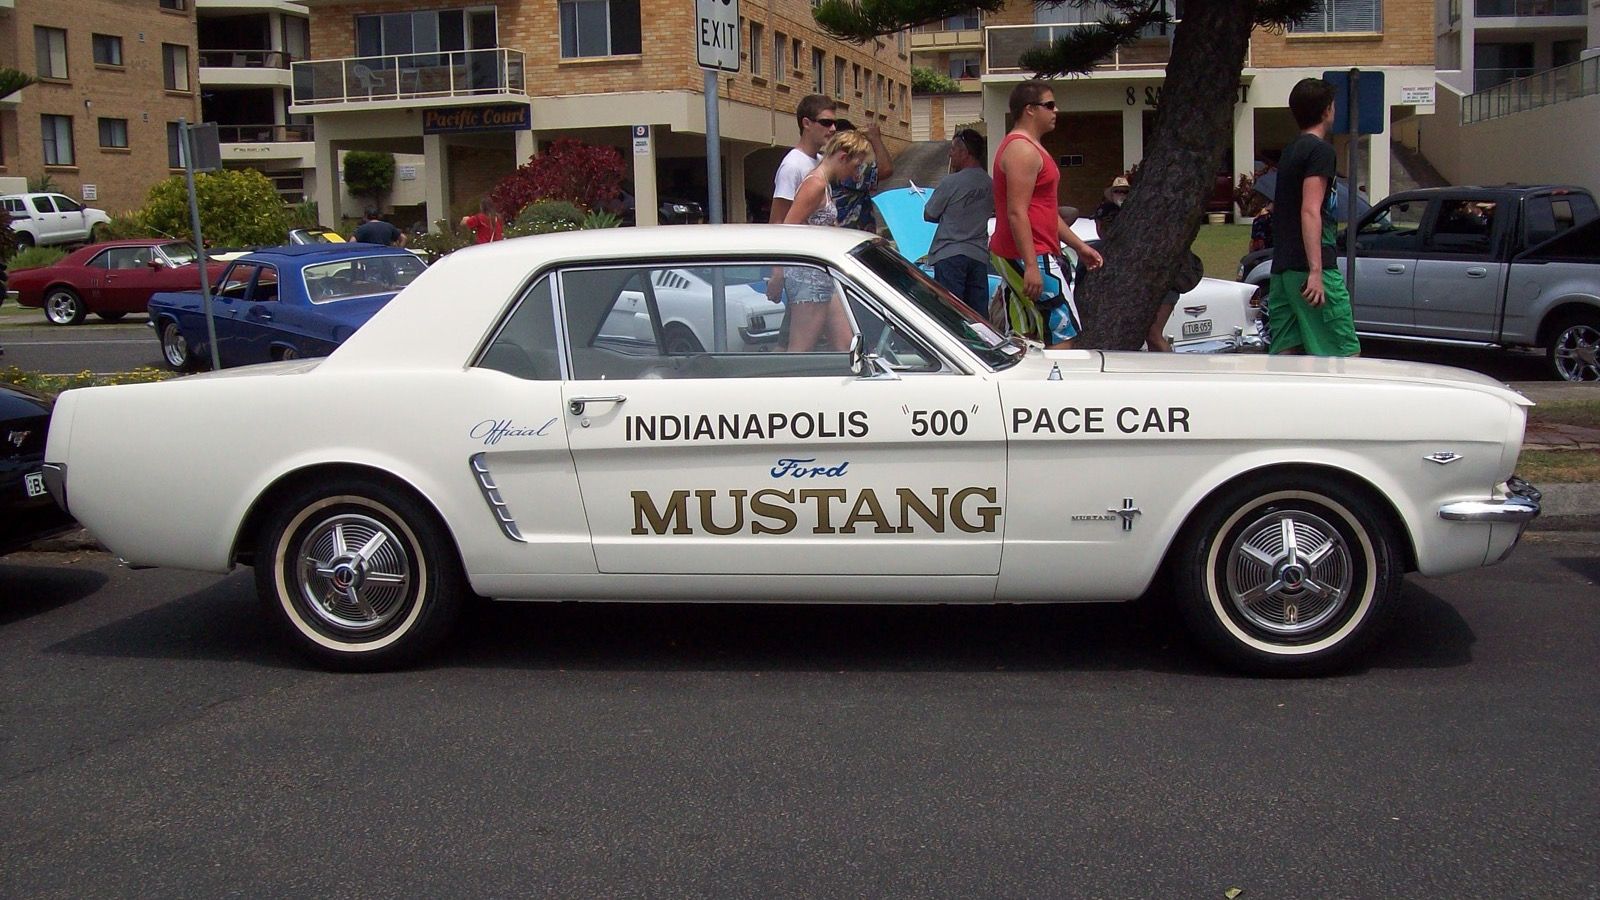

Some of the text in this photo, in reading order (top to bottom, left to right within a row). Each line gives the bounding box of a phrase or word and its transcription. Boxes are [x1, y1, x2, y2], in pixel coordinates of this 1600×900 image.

[701, 18, 735, 50] EXIT
[1126, 86, 1136, 106] 8
[425, 107, 526, 129] Pacific Court
[636, 126, 646, 136] 9
[469, 417, 558, 445] Official
[625, 411, 869, 441] INDIANAPOLIS
[1013, 408, 1104, 434] PACE
[1116, 407, 1191, 433] CAR
[770, 458, 849, 479] Ford
[630, 487, 1002, 535] MUSTANG
